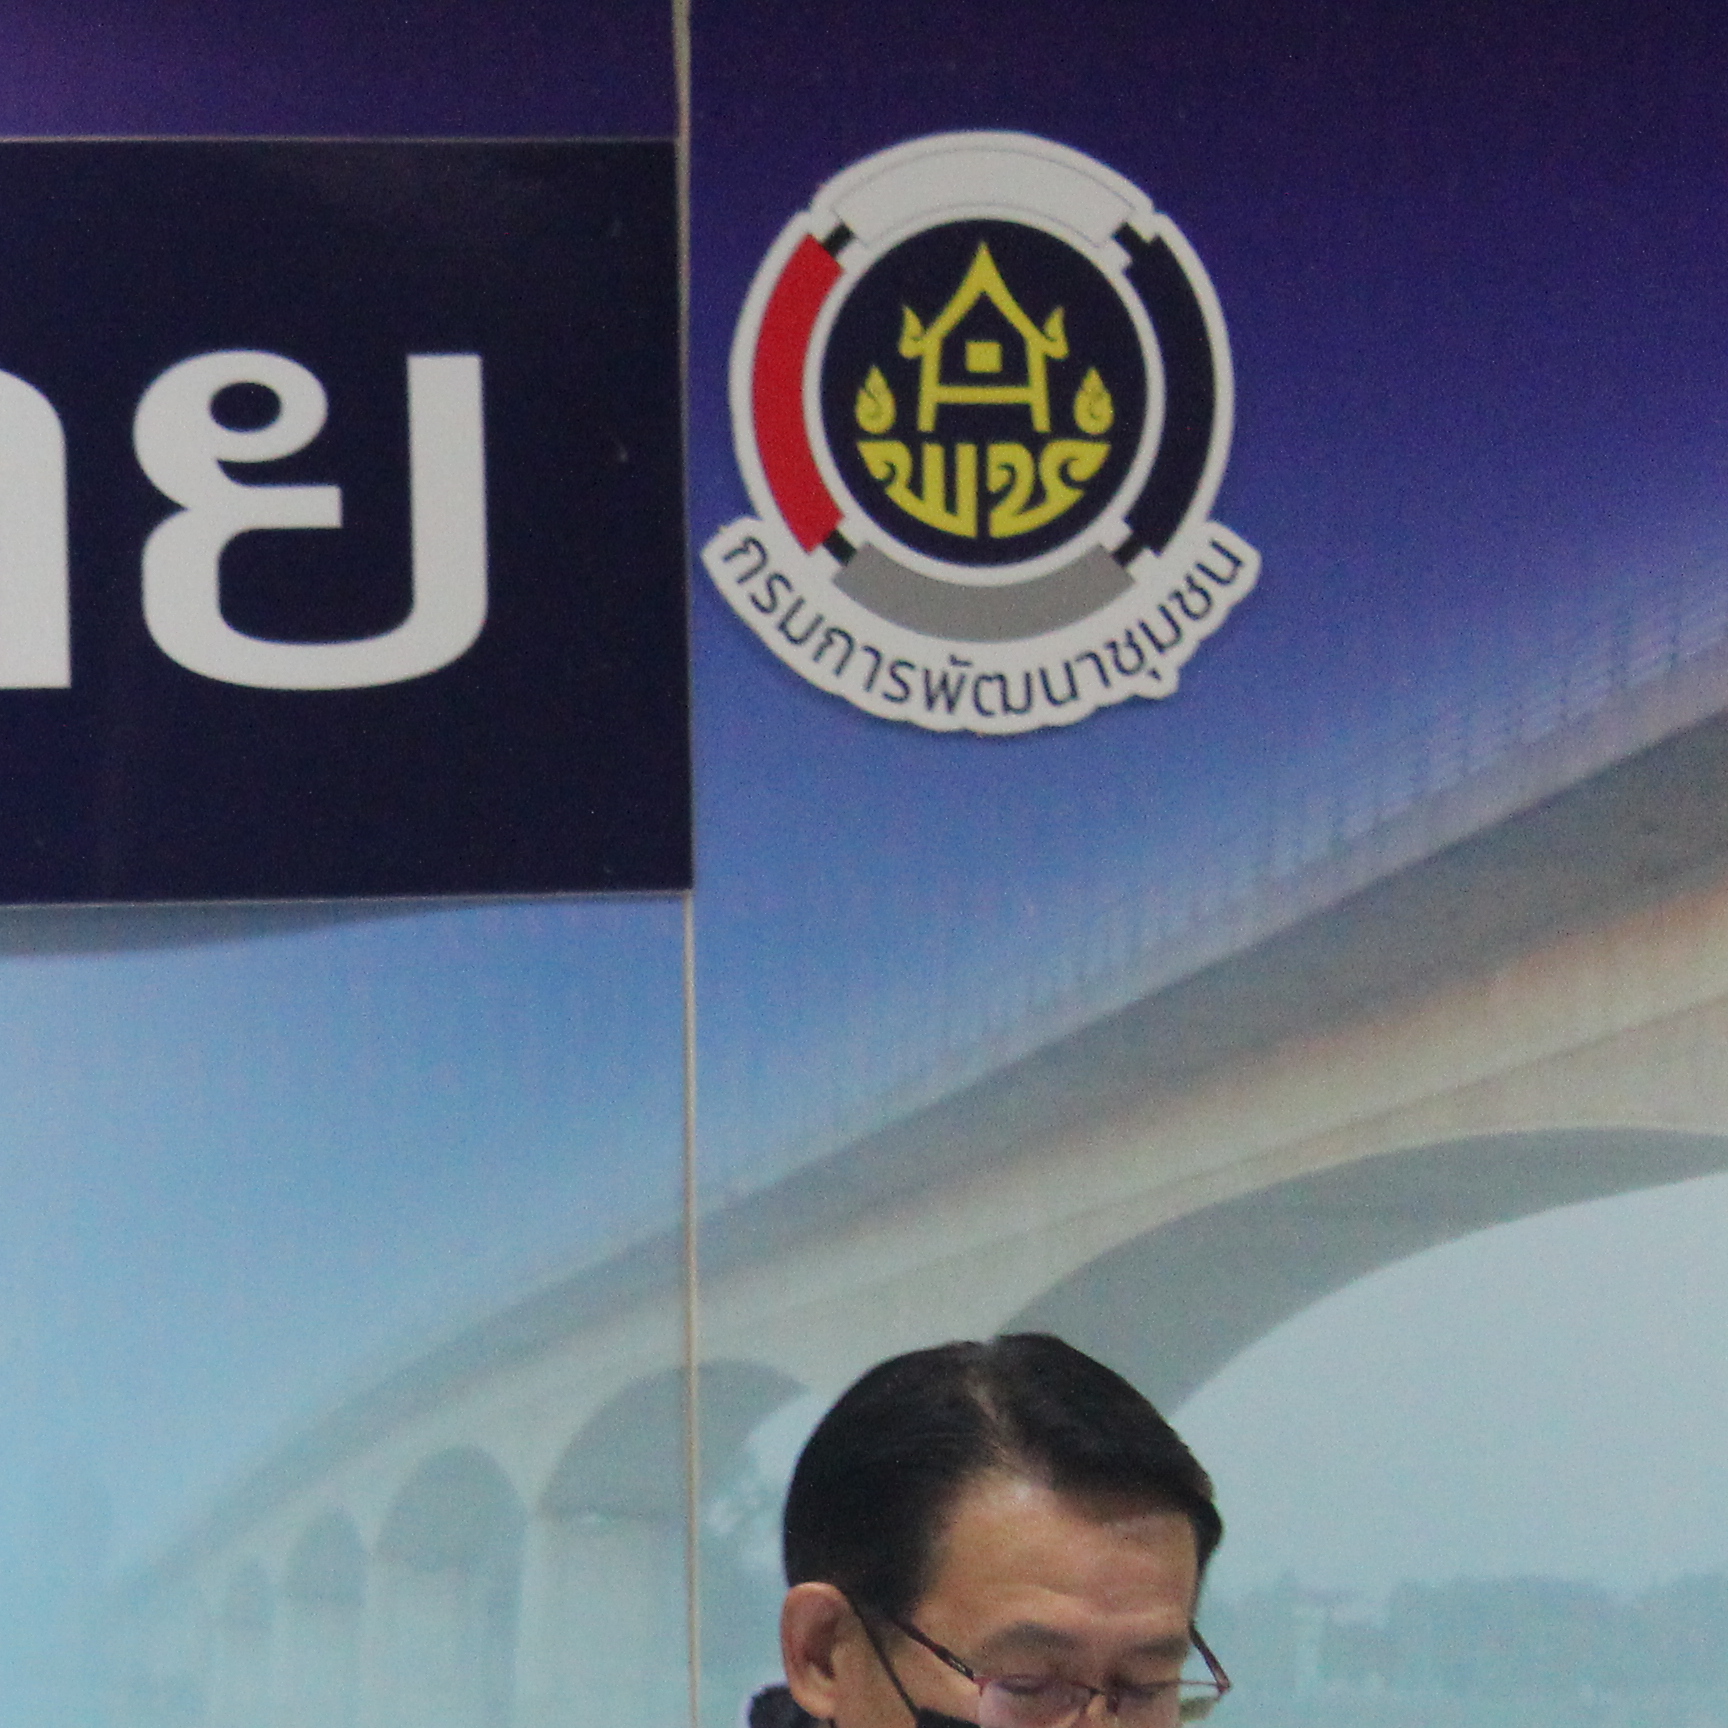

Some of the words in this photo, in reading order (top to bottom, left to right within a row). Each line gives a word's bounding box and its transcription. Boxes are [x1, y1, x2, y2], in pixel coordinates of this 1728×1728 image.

[720, 534, 1250, 718] กรมการพัฒนาชุมชน
